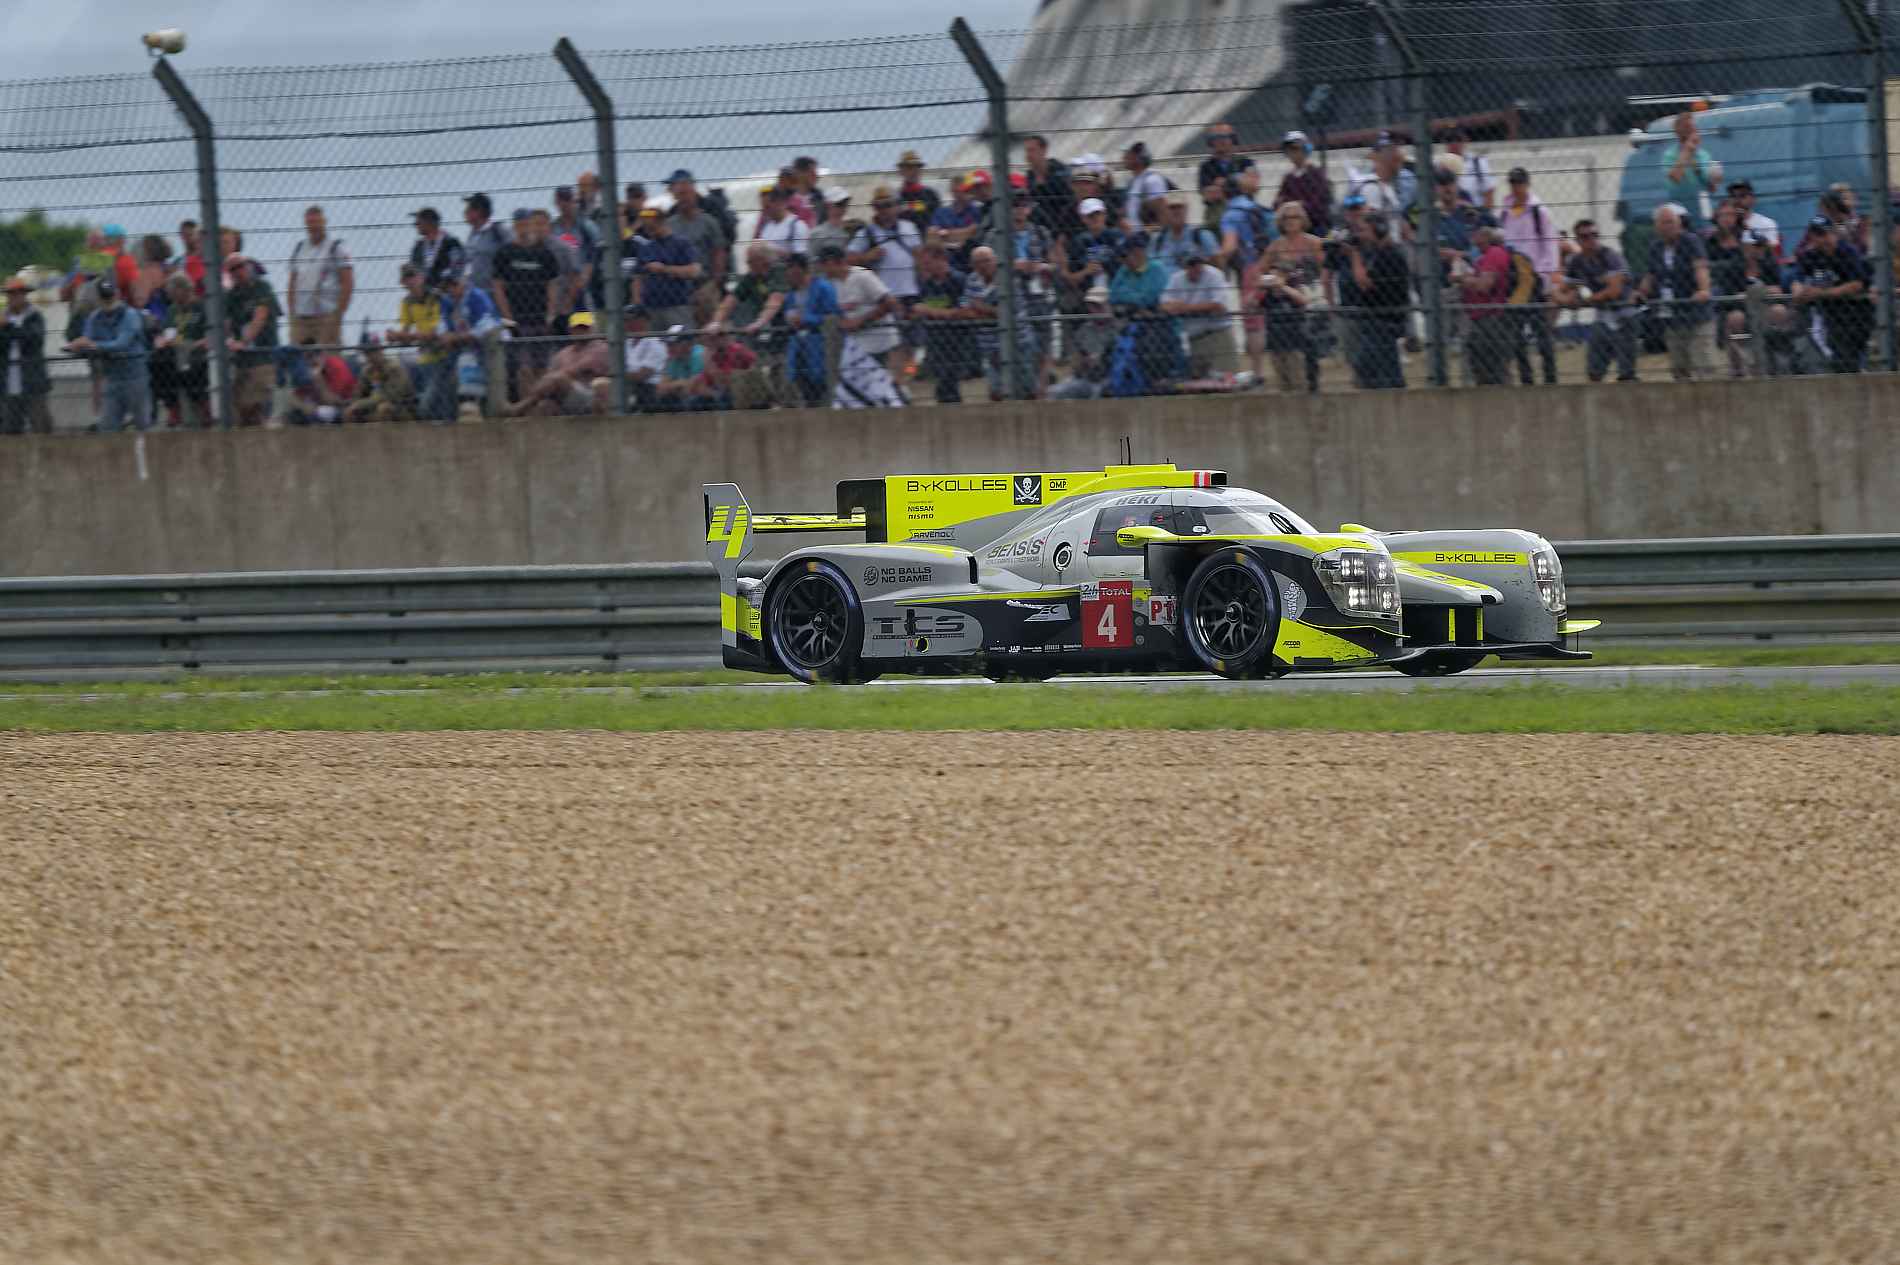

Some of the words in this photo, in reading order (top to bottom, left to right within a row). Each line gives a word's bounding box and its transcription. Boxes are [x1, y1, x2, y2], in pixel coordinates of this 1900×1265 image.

[1049, 481, 1067, 489] OMP
[707, 505, 748, 559] 4
[898, 566, 932, 575] BALLS
[898, 574, 932, 583] GAME!
[1101, 587, 1131, 596] TOTAL
[1097, 604, 1117, 642] 4
